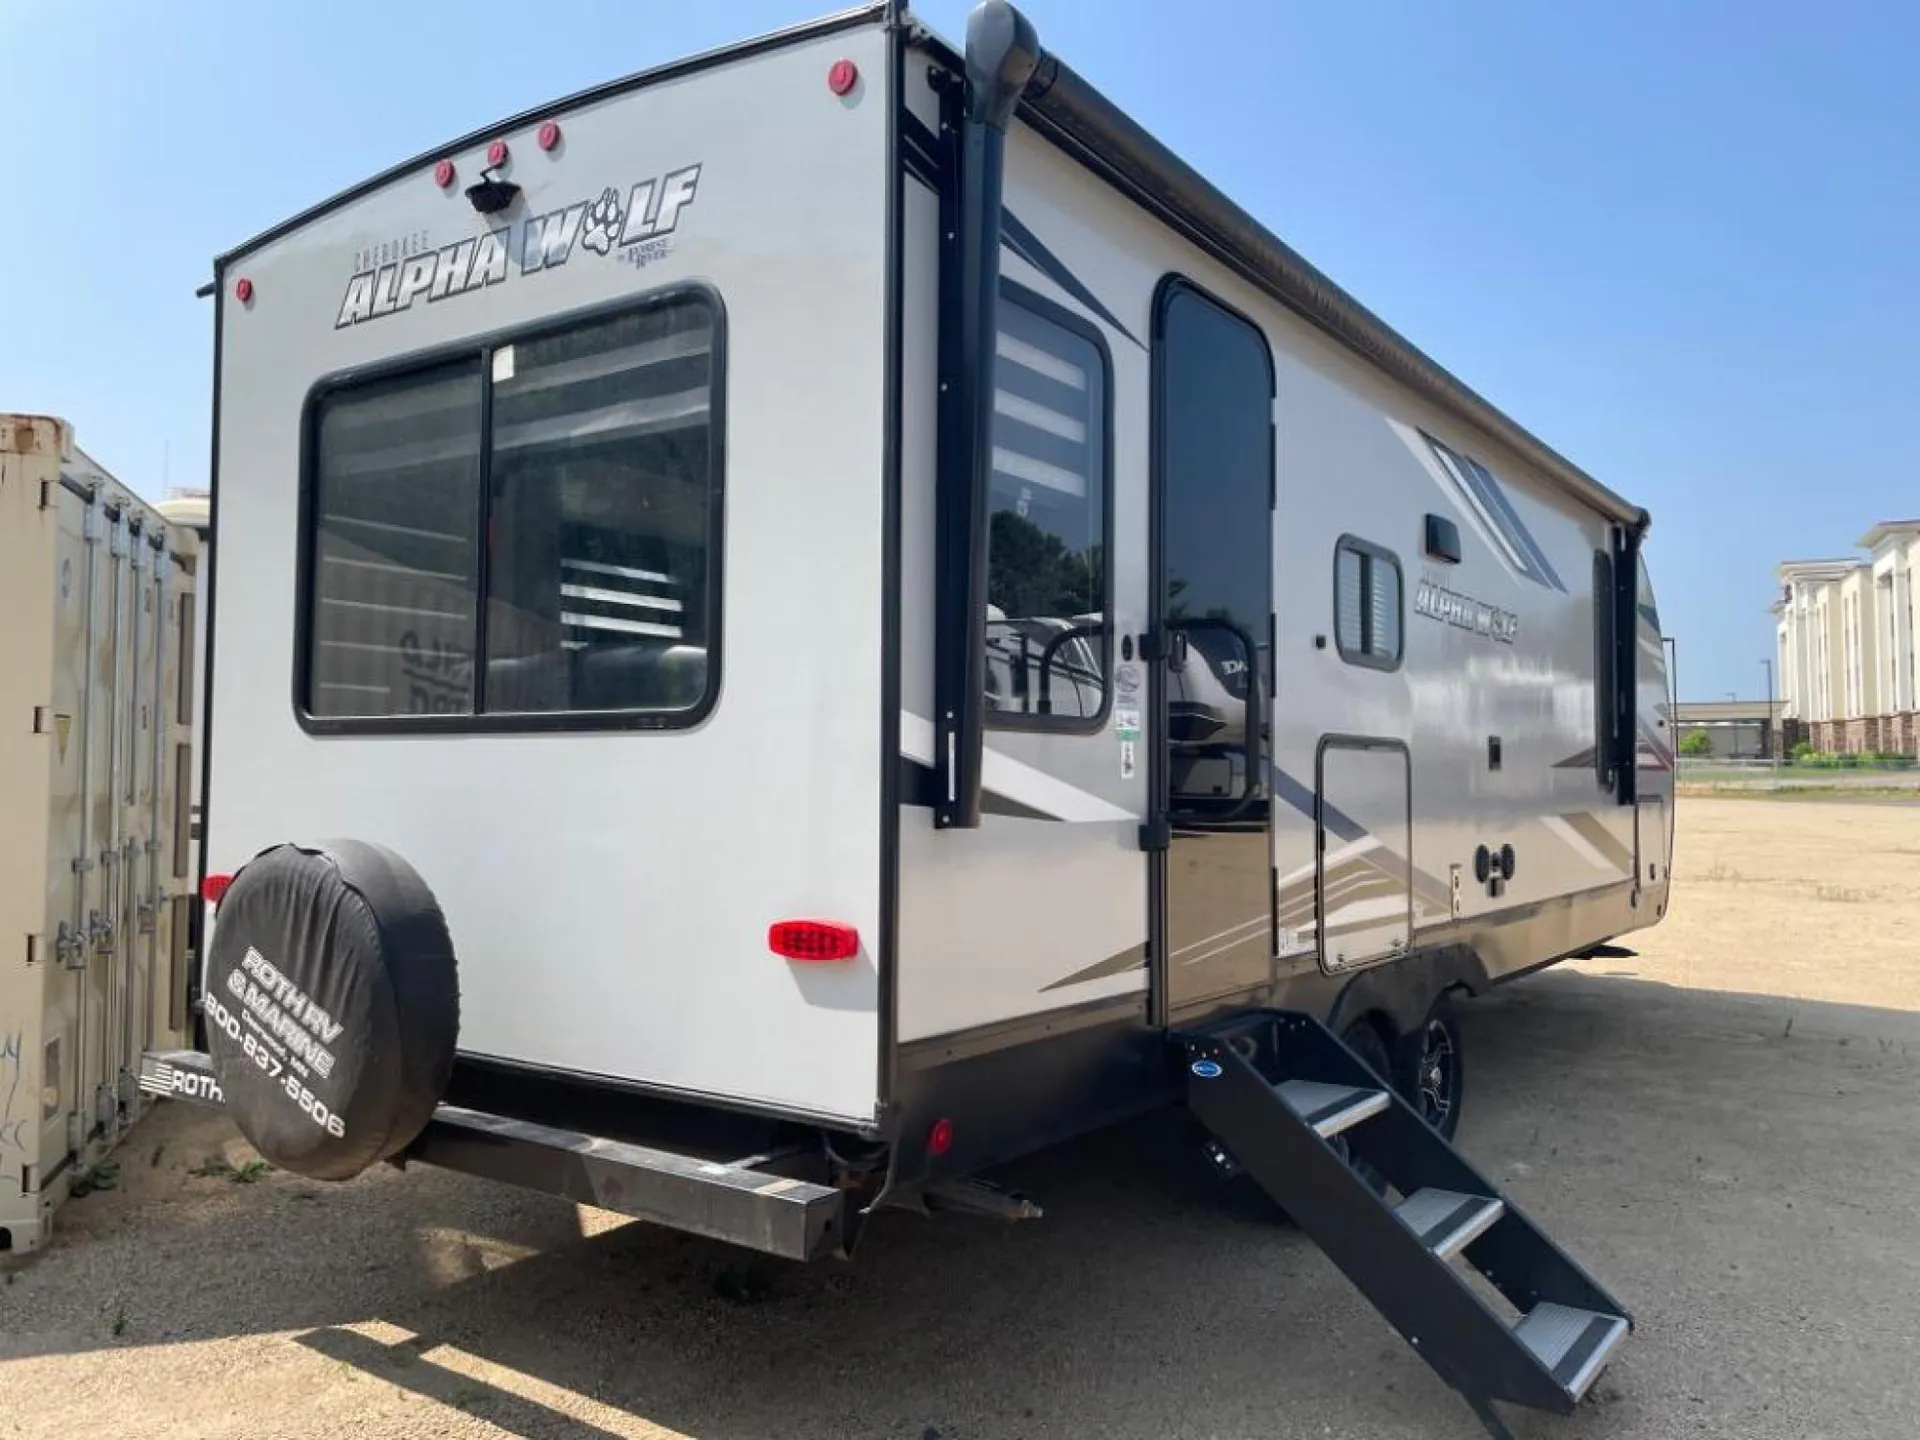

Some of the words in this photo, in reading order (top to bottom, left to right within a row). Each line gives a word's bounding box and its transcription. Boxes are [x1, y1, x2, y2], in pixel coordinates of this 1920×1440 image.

[335, 227, 511, 331] ALPHA
[1413, 577, 1474, 632] ALPHA
[242, 946, 308, 1018] ROTH
[301, 1000, 345, 1045] RV
[243, 981, 336, 1079] MARINE
[171, 1069, 223, 1103] ROTH
